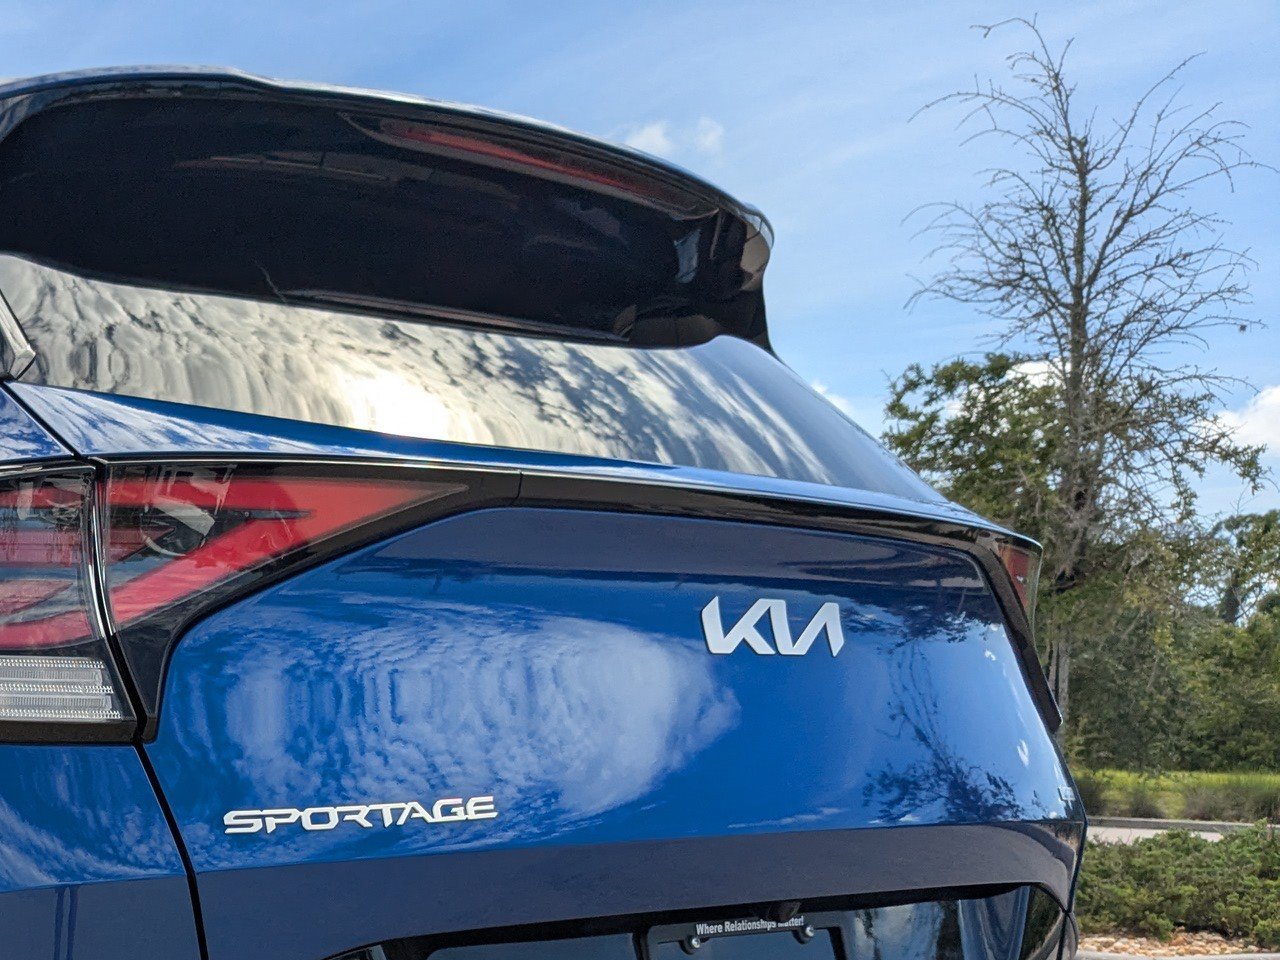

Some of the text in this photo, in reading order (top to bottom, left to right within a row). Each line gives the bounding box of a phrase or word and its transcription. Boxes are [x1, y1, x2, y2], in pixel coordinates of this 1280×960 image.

[701, 596, 845, 657] KIA
[223, 795, 498, 835] SPORTAGE
[696, 923, 723, 935] Where
